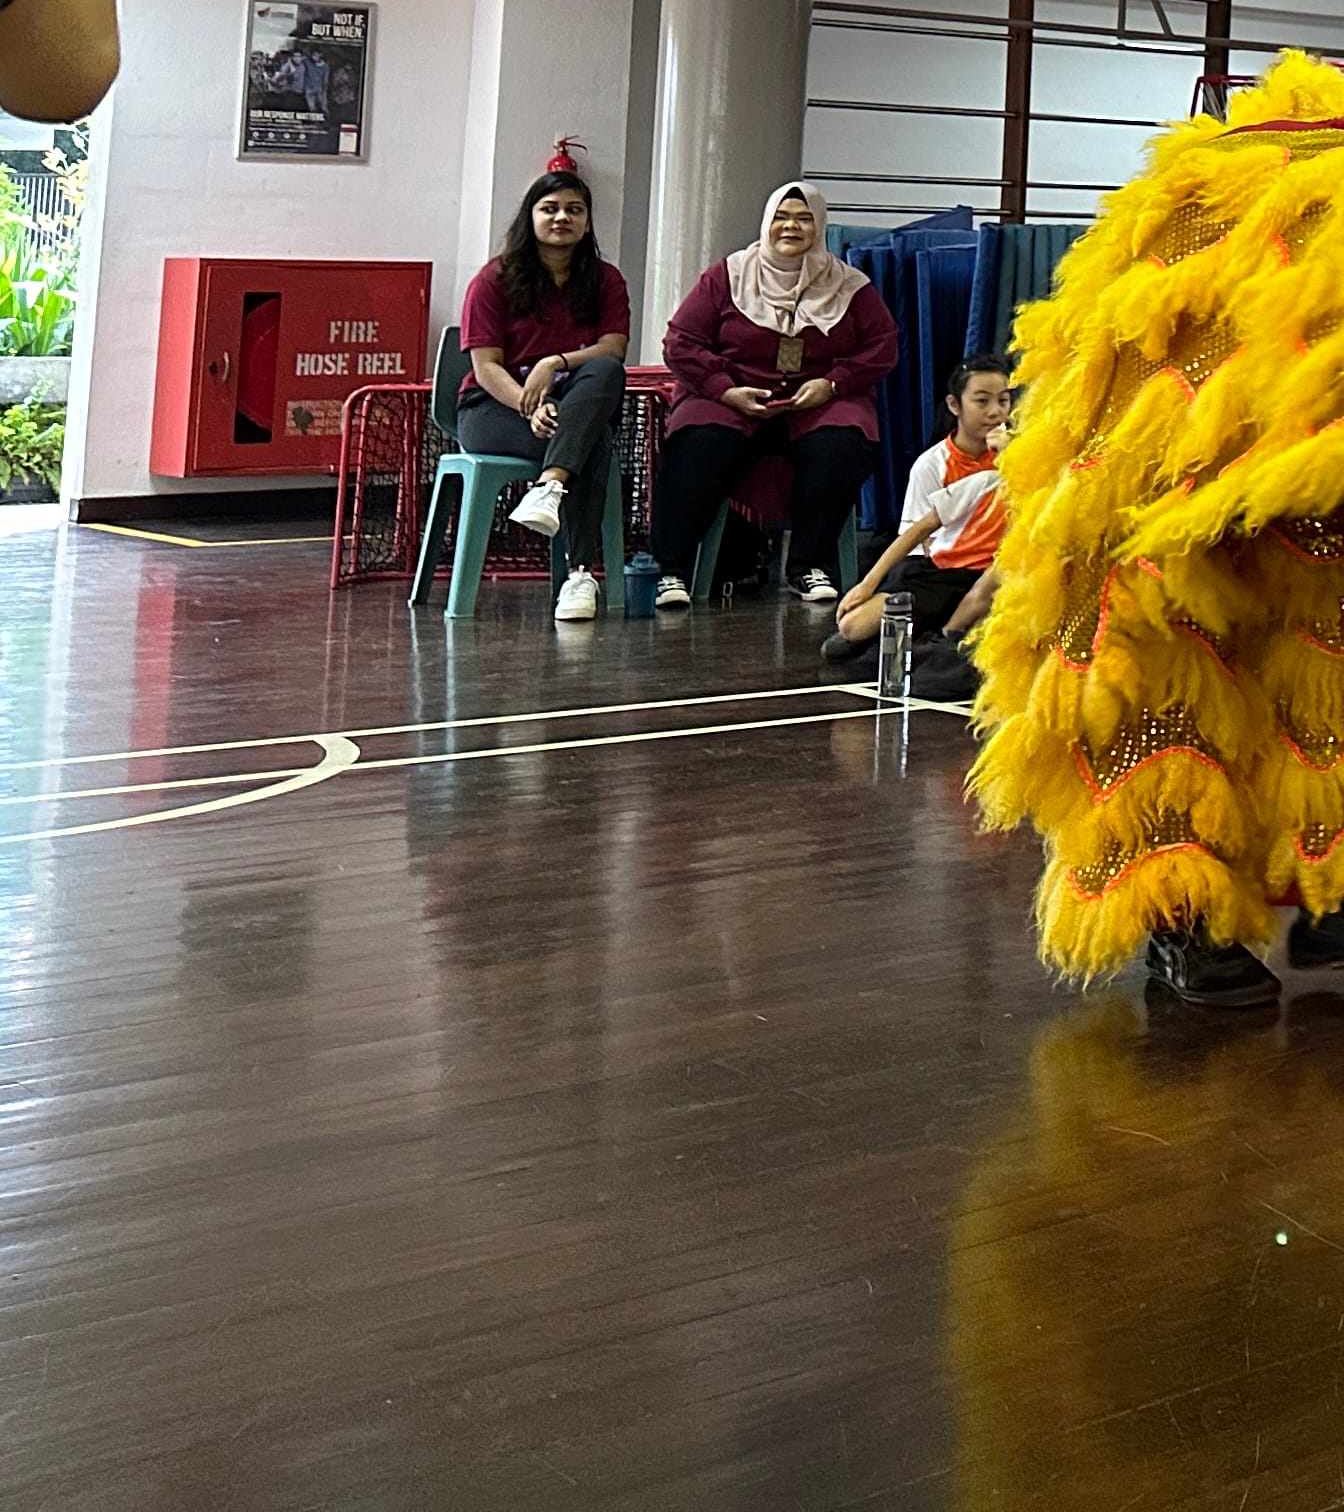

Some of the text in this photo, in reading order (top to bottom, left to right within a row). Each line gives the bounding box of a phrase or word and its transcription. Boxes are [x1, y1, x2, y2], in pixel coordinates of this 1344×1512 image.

[333, 13, 353, 25] NOT
[311, 23, 332, 36] BUT
[329, 320, 380, 343] FIRE
[296, 352, 406, 376] HOSE REEL
